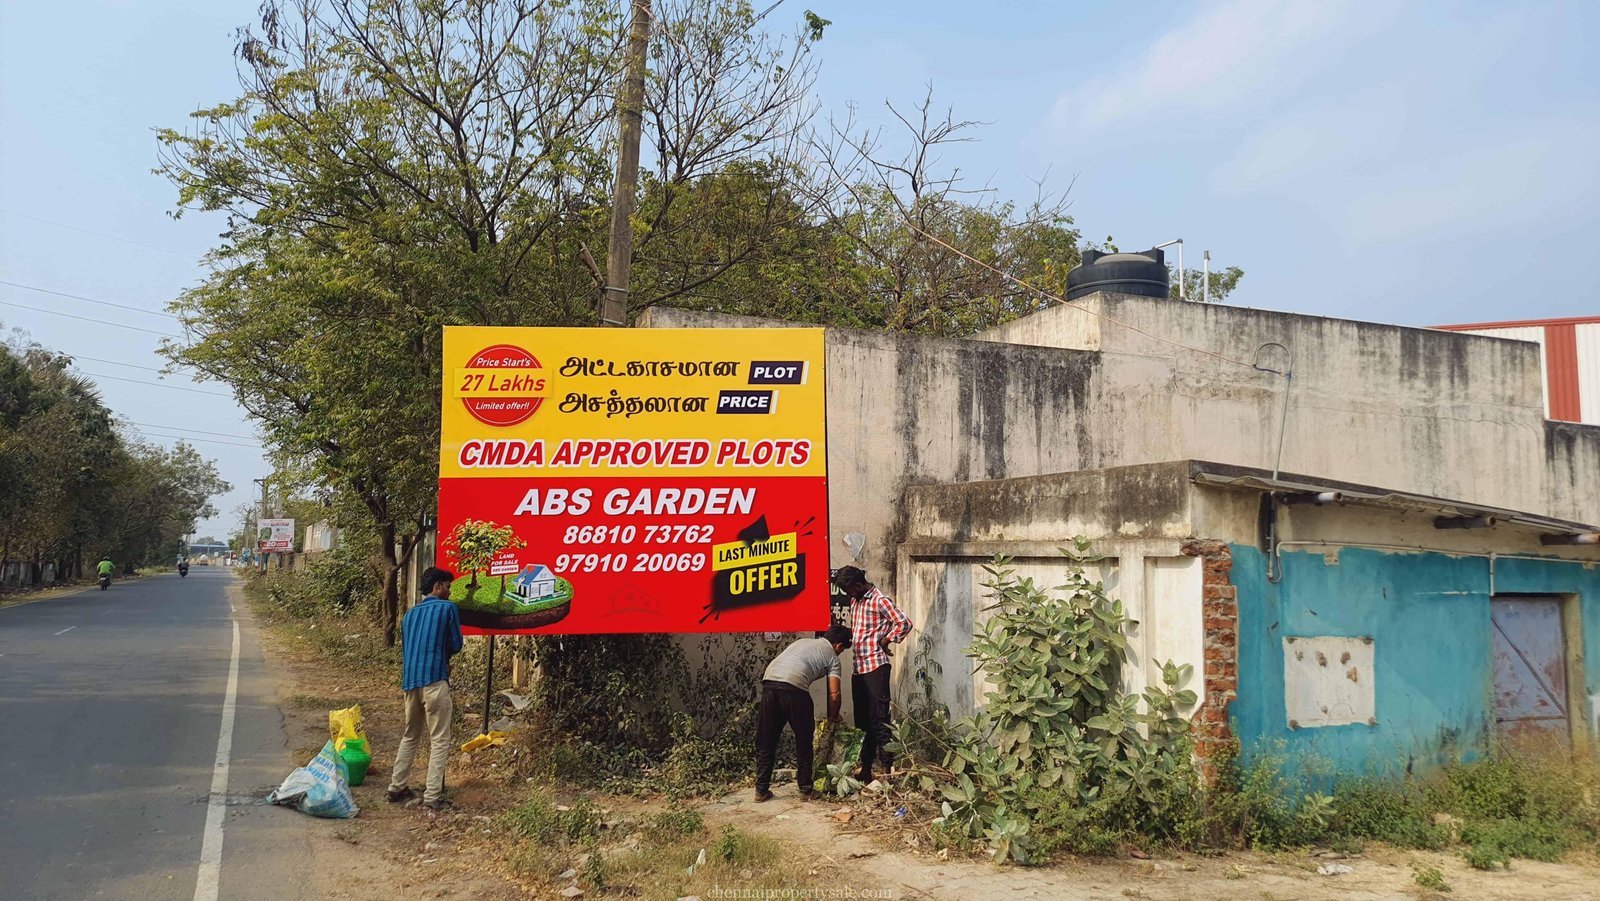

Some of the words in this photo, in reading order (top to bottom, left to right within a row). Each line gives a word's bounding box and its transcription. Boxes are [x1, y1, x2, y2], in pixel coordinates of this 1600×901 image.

[476, 357, 500, 367] Price
[502, 357, 532, 367] Start's
[559, 356, 741, 378] அட்டகாசமான
[753, 366, 798, 379] PLOT
[460, 374, 485, 392] 27
[488, 374, 546, 392] Lakhs
[475, 401, 505, 410] Limited
[506, 401, 530, 410] offer!!
[558, 389, 710, 419] அசத்தலான
[719, 396, 769, 408] PRICE
[460, 441, 544, 466] CMDA
[551, 441, 710, 466] APPROVED
[715, 441, 811, 466] PLOTS
[513, 488, 593, 516] ABS
[602, 488, 757, 516] GARDEN
[562, 525, 637, 545] 86810
[643, 525, 715, 544] 73762
[719, 546, 746, 563] LAST
[748, 539, 790, 558] MINUTE
[554, 553, 628, 573] 97910
[632, 553, 706, 572] 20069
[729, 561, 798, 595] OFFER
